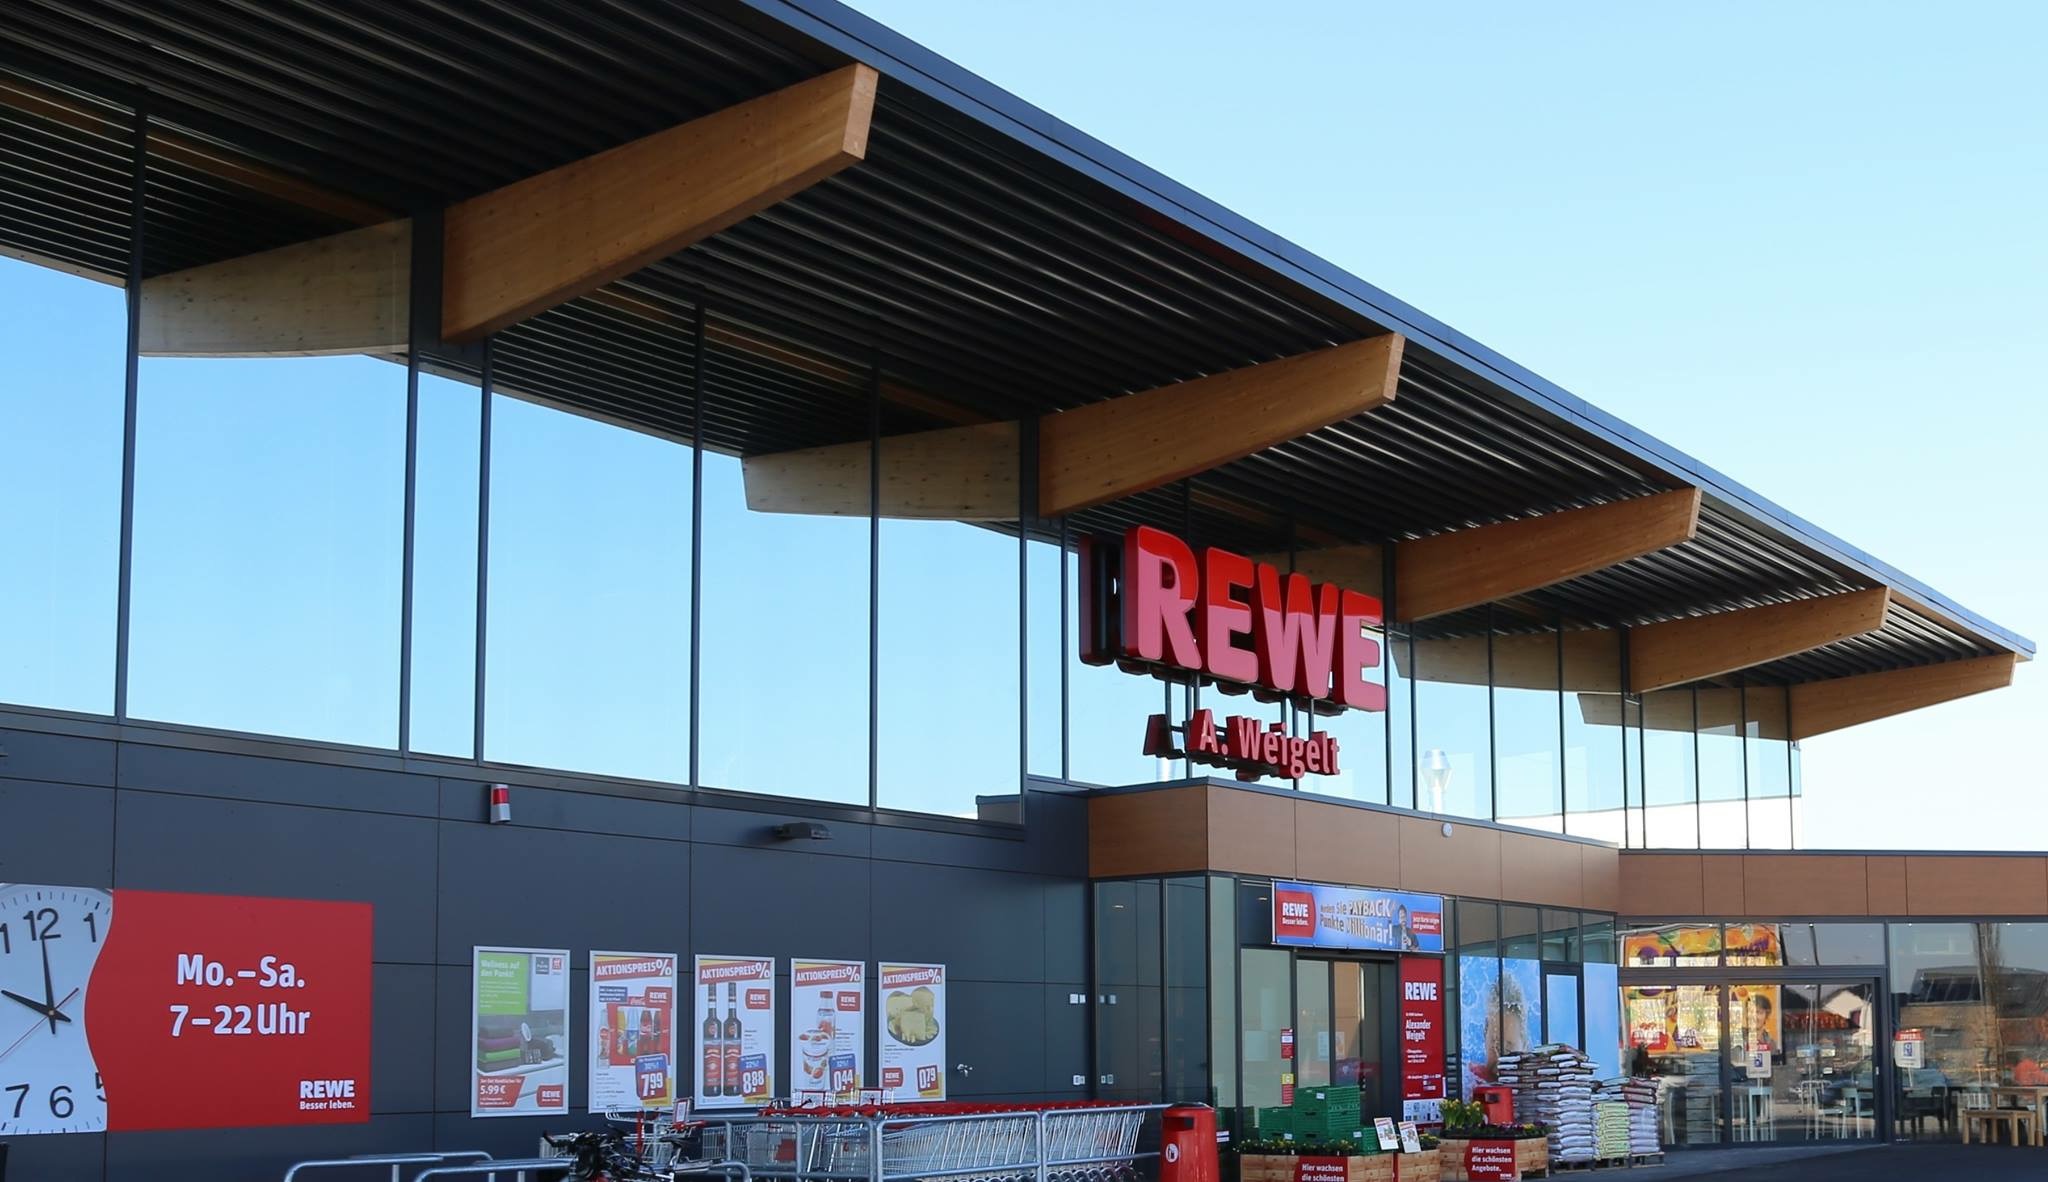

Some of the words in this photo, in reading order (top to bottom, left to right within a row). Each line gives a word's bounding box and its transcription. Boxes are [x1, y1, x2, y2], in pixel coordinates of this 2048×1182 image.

[1136, 525, 1387, 712] REWE
[1199, 709, 1229, 756] A.
[1237, 715, 1341, 779] Weigelt
[1282, 902, 1309, 918] REWE
[1336, 901, 1347, 915] Sie
[1349, 898, 1392, 918] PAYBACK
[23, 908, 61, 941] 12
[83, 912, 97, 943] 1
[1320, 914, 1345, 932] Punkte
[1405, 982, 1437, 1001] REWE
[257, 1002, 311, 1035] Uhr
[300, 1080, 355, 1099] REWE
[5, 1083, 30, 1118] 7
[49, 1085, 74, 1119] 6
[300, 1101, 328, 1110] Besser
[329, 1100, 355, 1109] leben.
[1302, 1163, 1315, 1171] Hier
[1317, 1164, 1343, 1172] wachsen
[1471, 1155, 1481, 1163] die
[1482, 1155, 1512, 1163] schönsten
